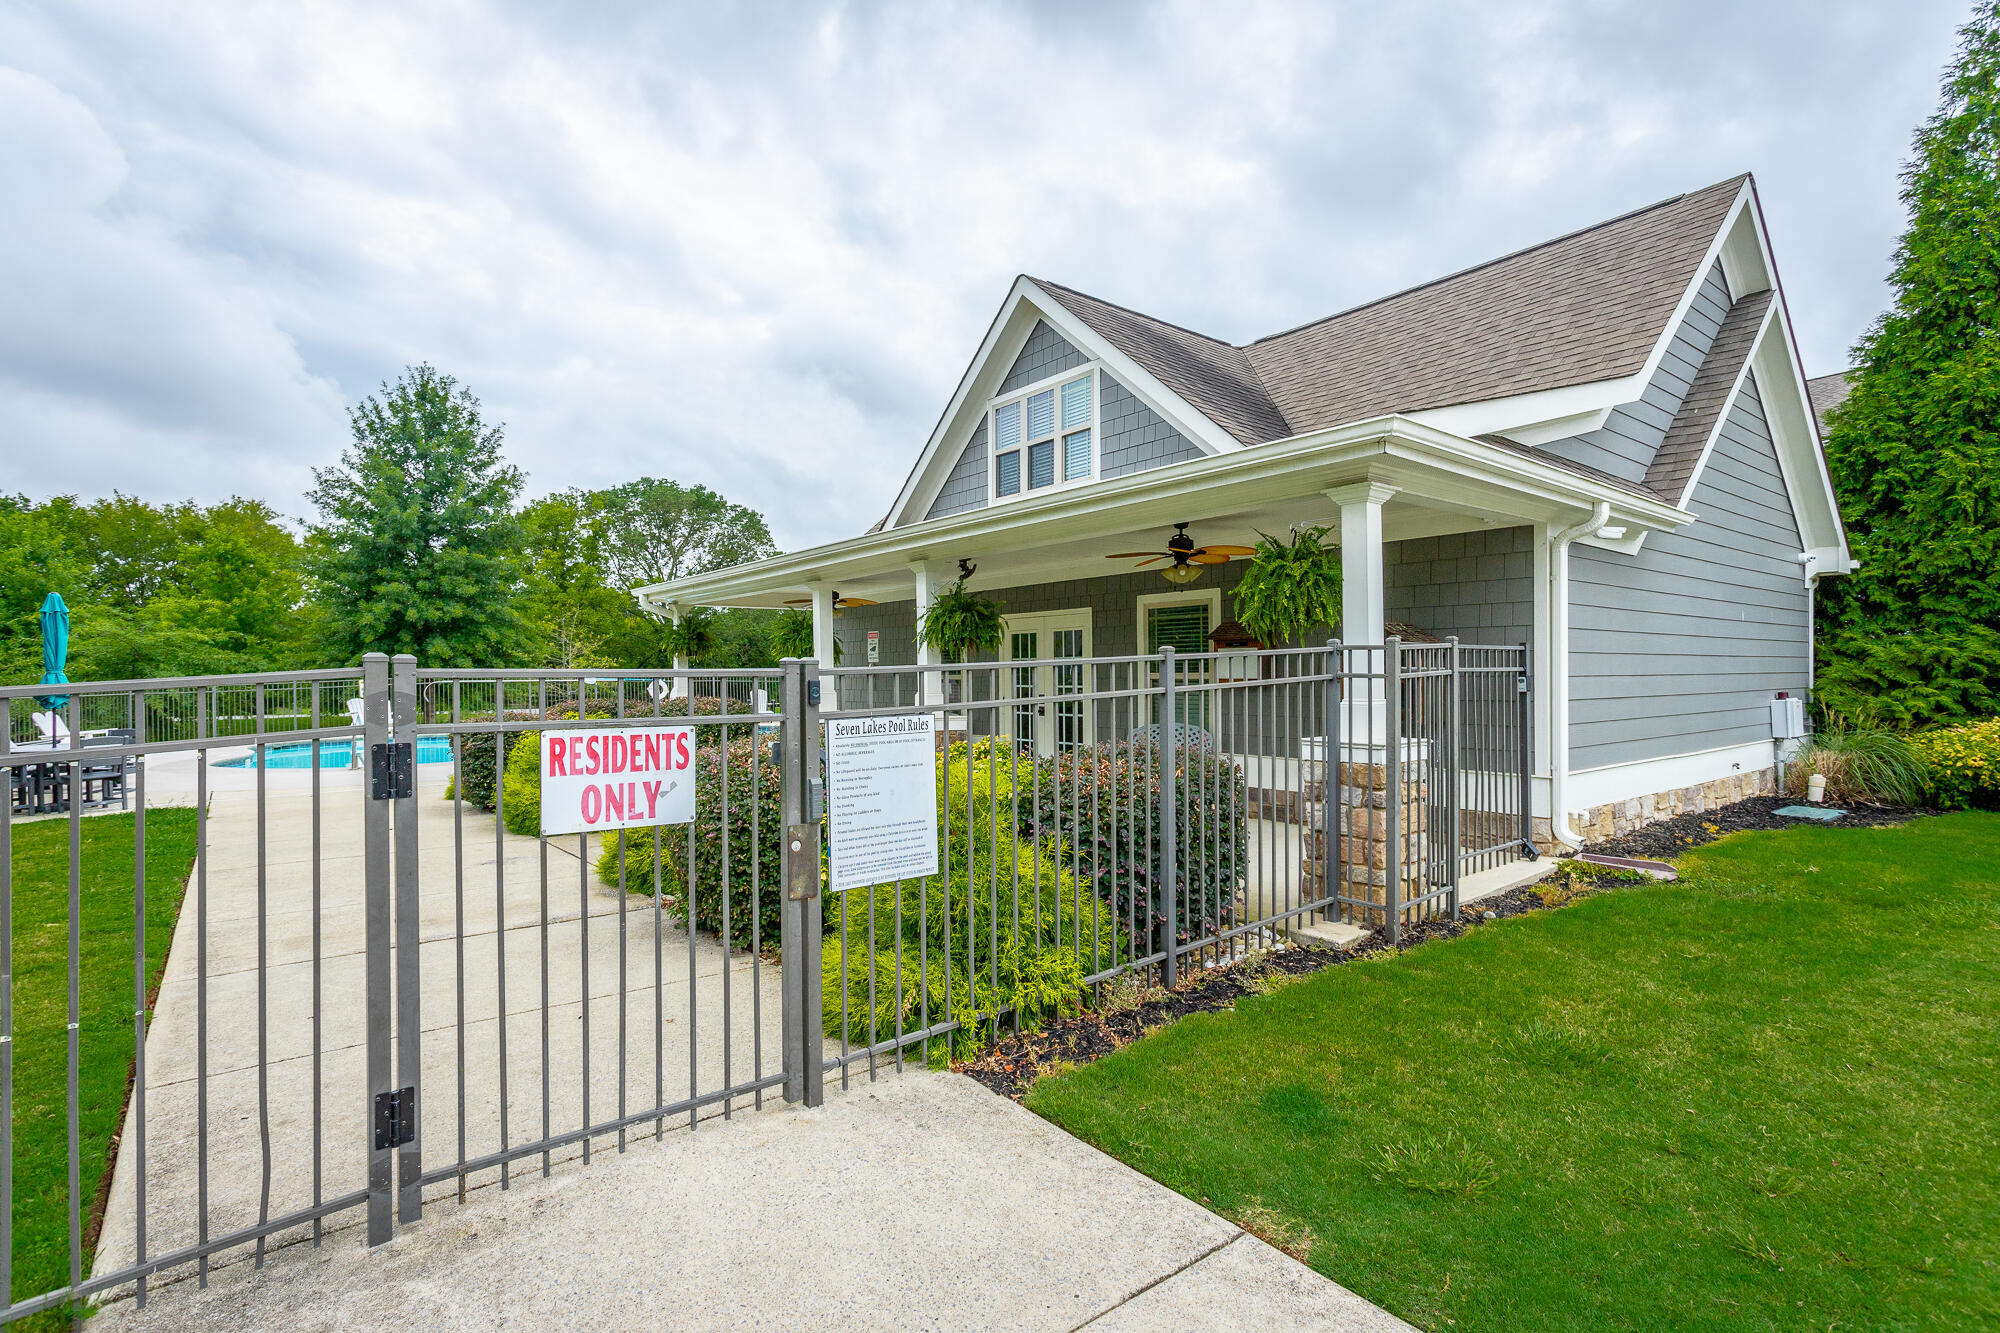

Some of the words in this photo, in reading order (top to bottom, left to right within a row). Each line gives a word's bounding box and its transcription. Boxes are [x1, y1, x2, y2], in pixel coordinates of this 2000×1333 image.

[836, 723, 860, 736] Seven
[863, 720, 887, 734] Lakes
[888, 718, 906, 733] Pool
[908, 717, 929, 732] Rules
[549, 731, 690, 777] RESIDENTS
[580, 780, 662, 824] ONLY
